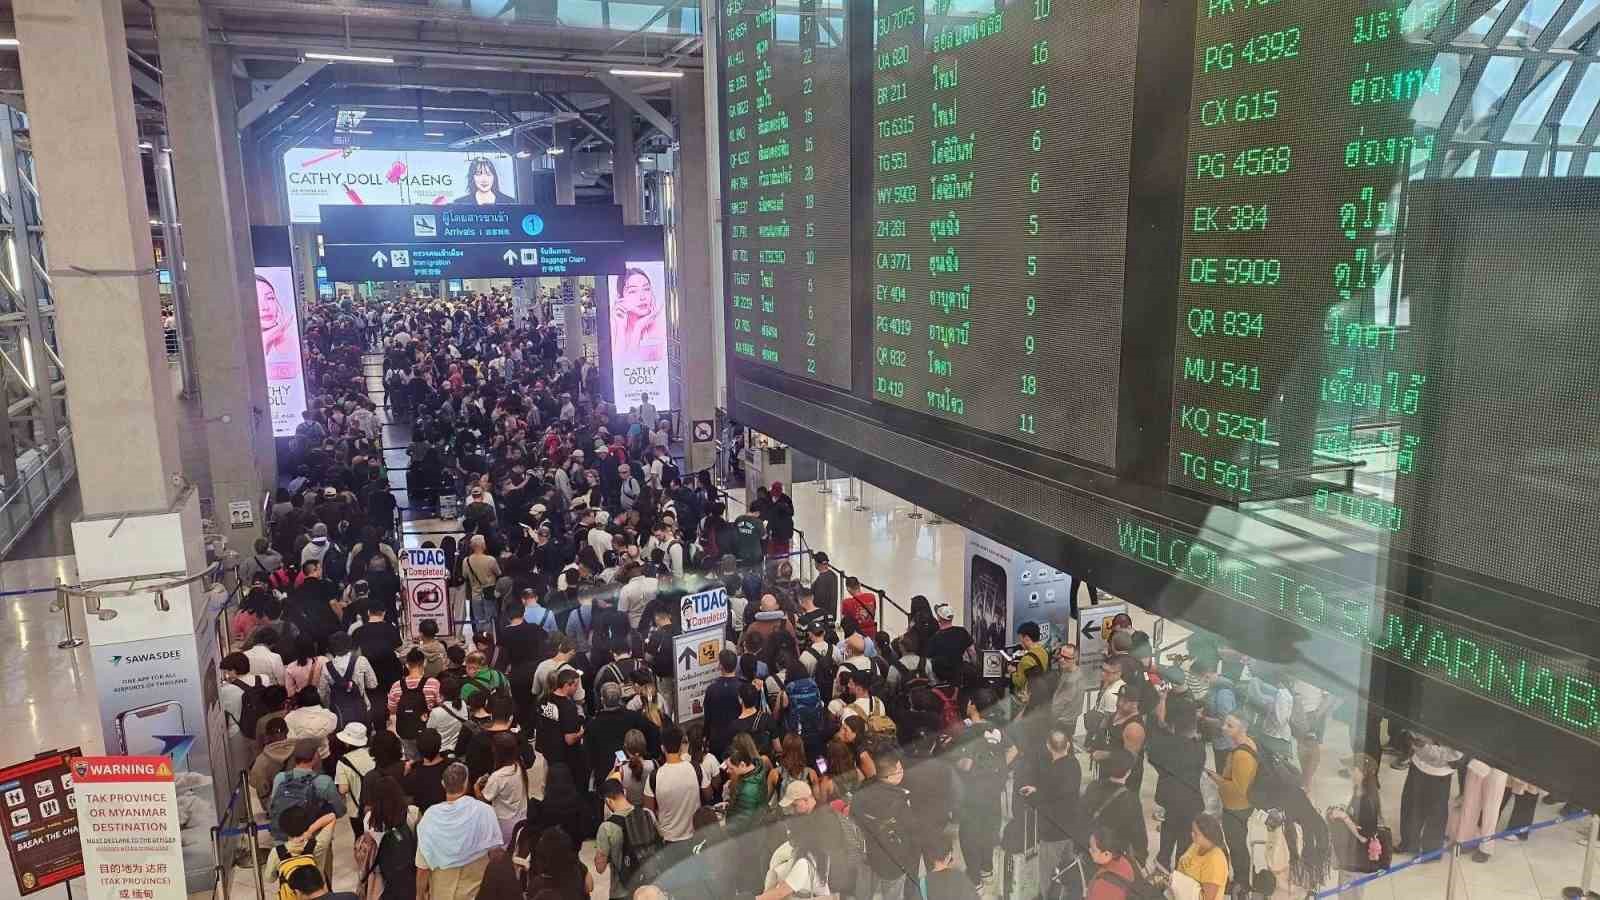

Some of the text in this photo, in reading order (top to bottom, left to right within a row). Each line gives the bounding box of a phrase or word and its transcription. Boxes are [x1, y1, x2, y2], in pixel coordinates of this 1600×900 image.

[1032, 41, 1049, 65] 16
[1204, 27, 1300, 73] PG 4392
[878, 52, 890, 71] UA
[888, 82, 908, 104] 211
[1030, 86, 1047, 109] 16
[1199, 90, 1279, 127] CX 615
[878, 120, 891, 139] TG
[1032, 130, 1042, 152] 6
[878, 152, 908, 172] TG 551
[1196, 145, 1292, 180] PG 4568
[289, 172, 453, 187] CATHY DOLL MAENG
[1030, 172, 1040, 194] 6
[878, 188, 892, 204] WY
[1029, 214, 1039, 235] 5
[1192, 204, 1269, 232] EK 384
[444, 228, 476, 236] Arrivals
[876, 253, 912, 271] CA 3771
[1028, 256, 1037, 276] 5
[1189, 258, 1281, 286] DE 5909
[876, 284, 890, 302] EY
[1026, 296, 1036, 316] 9
[876, 316, 912, 337] PG 4019
[1187, 308, 1265, 339] QR 834
[1025, 336, 1034, 355] 9
[876, 347, 907, 368] QR 832
[624, 366, 658, 376] CATHY
[628, 376, 654, 384] DOLL
[1183, 357, 1262, 393] MU 541
[888, 379, 904, 399] 419
[1022, 375, 1037, 396] 18
[1019, 414, 1035, 434] 11
[1181, 404, 1268, 443] KQ 5251
[1179, 452, 1252, 494] TG 561
[408, 550, 444, 565] TDAC
[408, 567, 444, 578] Completed
[1116, 517, 1257, 601] WELCOME
[1271, 572, 1325, 626] TO
[692, 588, 728, 614] TDAC
[692, 610, 727, 626] Completed
[126, 650, 181, 665] SAWASDEE
[91, 764, 154, 776] WARNING
[87, 792, 167, 804] TAK PROVINCE
[90, 808, 167, 818] OR MYANMAR
[92, 822, 167, 832] DESTINATION
[17, 838, 44, 852] BREAK
[46, 832, 61, 842] THE
